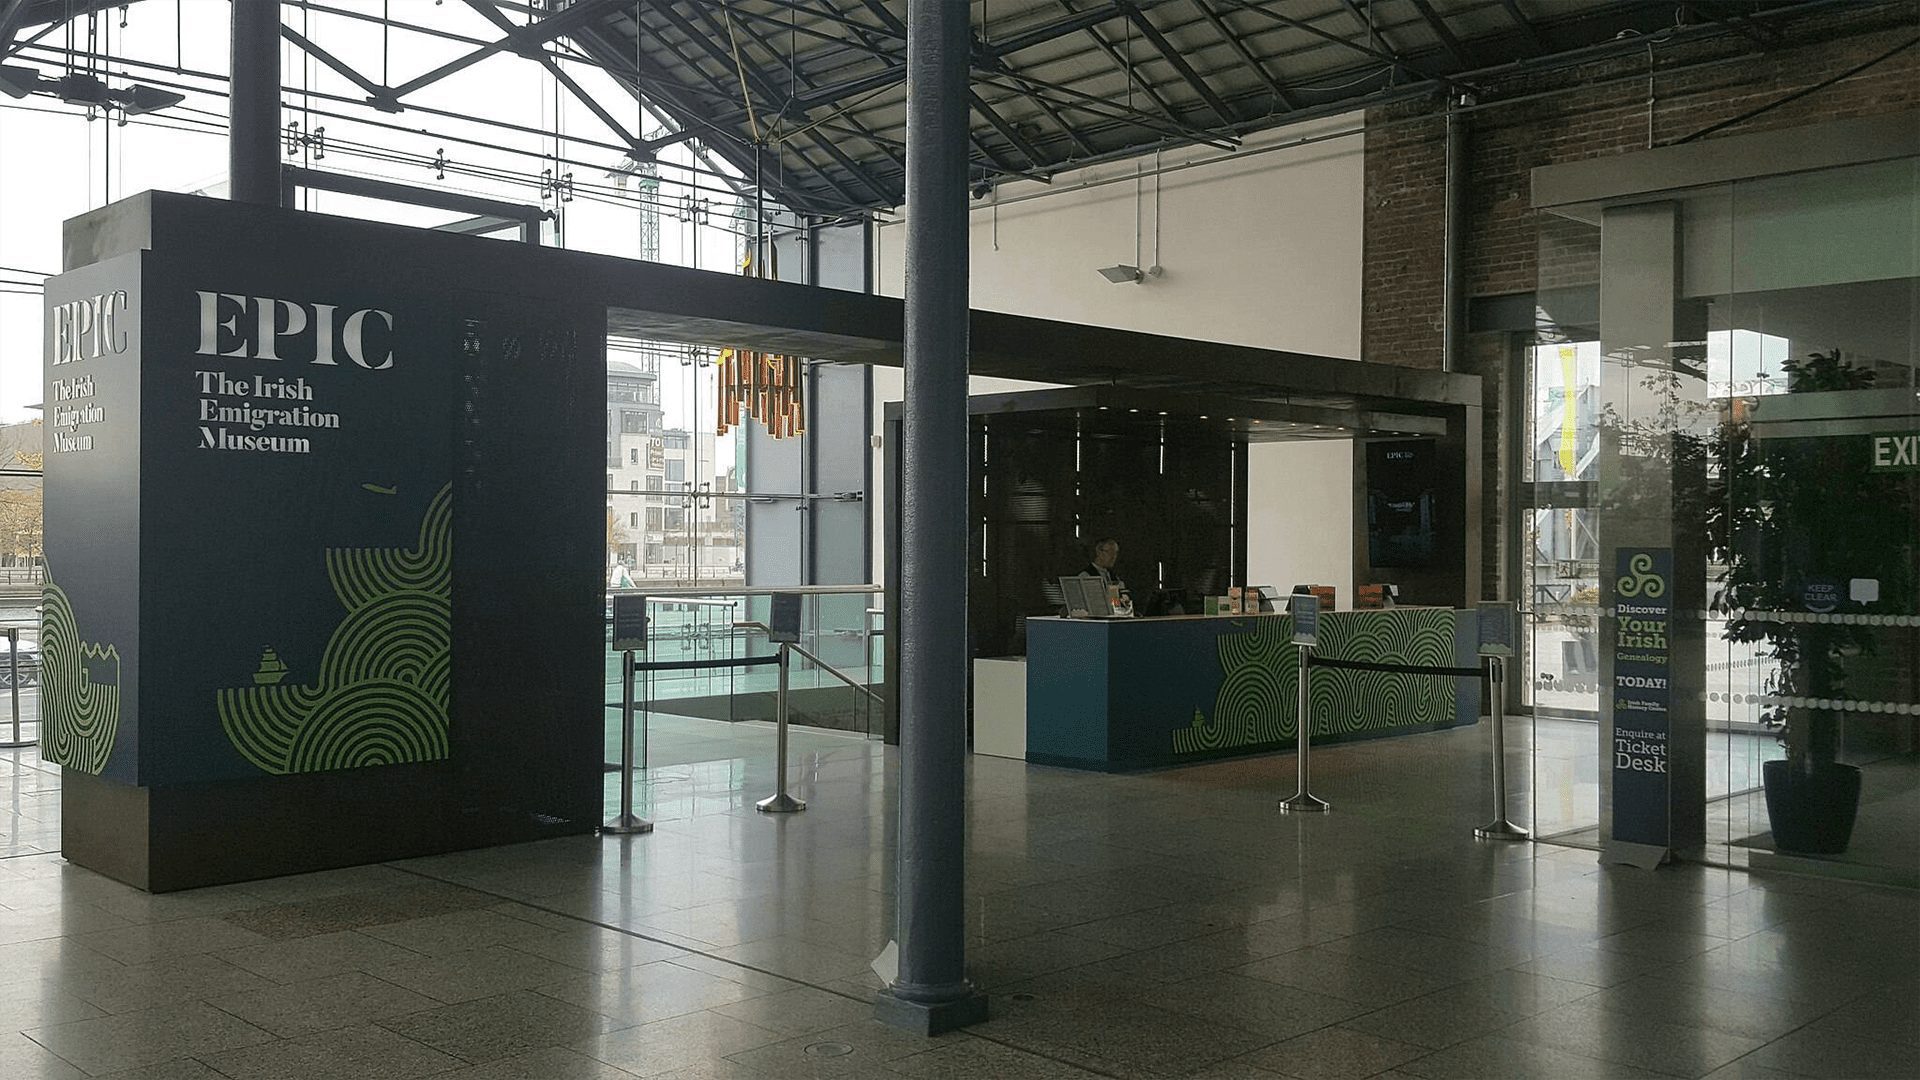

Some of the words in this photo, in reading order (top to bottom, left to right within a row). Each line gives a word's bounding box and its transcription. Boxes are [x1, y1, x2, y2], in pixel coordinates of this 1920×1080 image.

[53, 289, 128, 366] EPIC
[195, 290, 394, 370] EPIC
[53, 380, 72, 401] The
[72, 375, 95, 400] Irish
[195, 370, 249, 396] The
[254, 375, 313, 401] Irish
[54, 403, 105, 432] Emigration
[199, 398, 340, 431] Emigration
[53, 432, 94, 453] Museum
[198, 426, 311, 453] Museum
[1875, 435, 1920, 466] EXI
[1804, 592, 1838, 601] CLEAR
[1808, 584, 1834, 592] KEEP
[1617, 604, 1668, 615] Discover
[1617, 615, 1667, 633] Your
[1617, 631, 1668, 649] Irish
[1616, 652, 1668, 664] Genealogy
[1616, 676, 1667, 689] TODAY!
[1616, 727, 1655, 739] Enquire
[1656, 732, 1666, 740] at
[1616, 739, 1667, 756] Ticket
[1616, 752, 1667, 773] Desk
